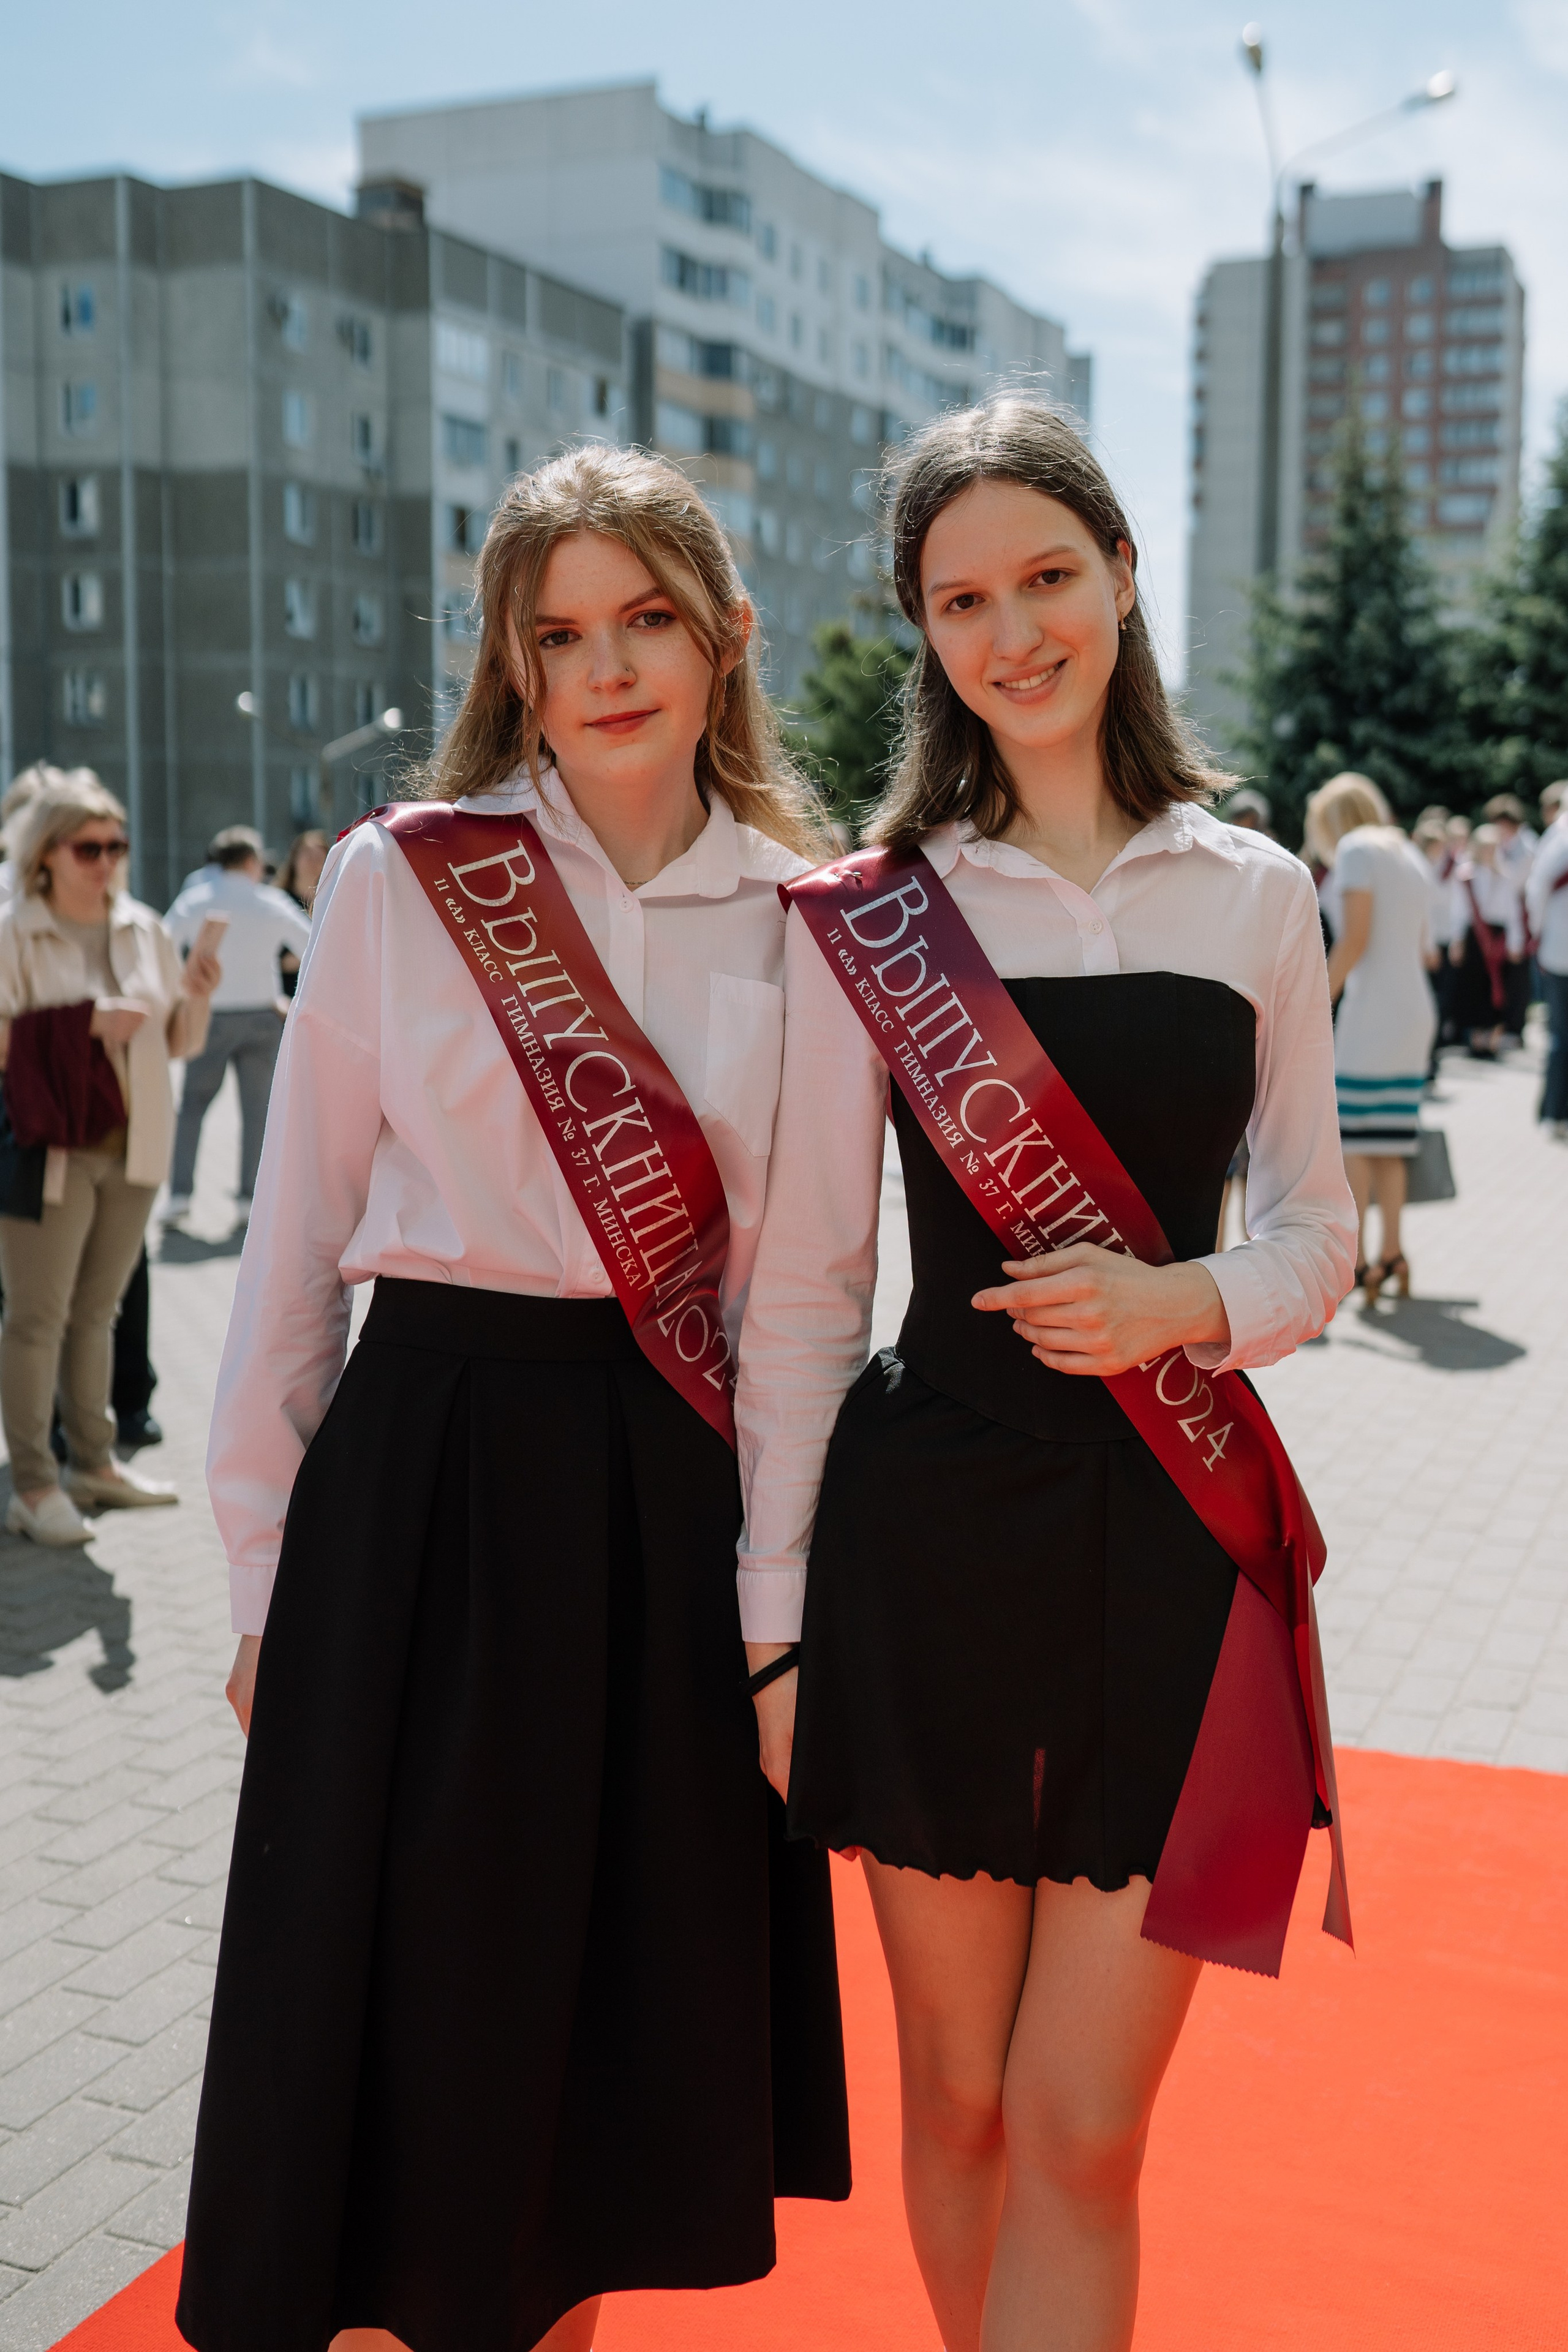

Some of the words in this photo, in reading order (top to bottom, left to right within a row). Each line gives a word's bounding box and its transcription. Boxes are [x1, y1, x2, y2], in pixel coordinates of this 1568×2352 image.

[434, 878, 450, 892] 11
[445, 897, 466, 924] «А»
[463, 928, 503, 983] КЛАСС
[501, 994, 565, 1112] ГИМНАЗИЯ
[557, 1117, 576, 1142] №
[571, 1148, 591, 1166] 37
[593, 1197, 641, 1287] МИНСКА
[827, 928, 842, 944] 11
[837, 949, 857, 975] «А»
[855, 977, 894, 1033] КЛАСС
[894, 1039, 965, 1148] ГИМНАЗИЯ
[959, 1150, 980, 1175] №
[979, 1178, 1000, 1197] 37
[1138, 1349, 1234, 1472] 024
